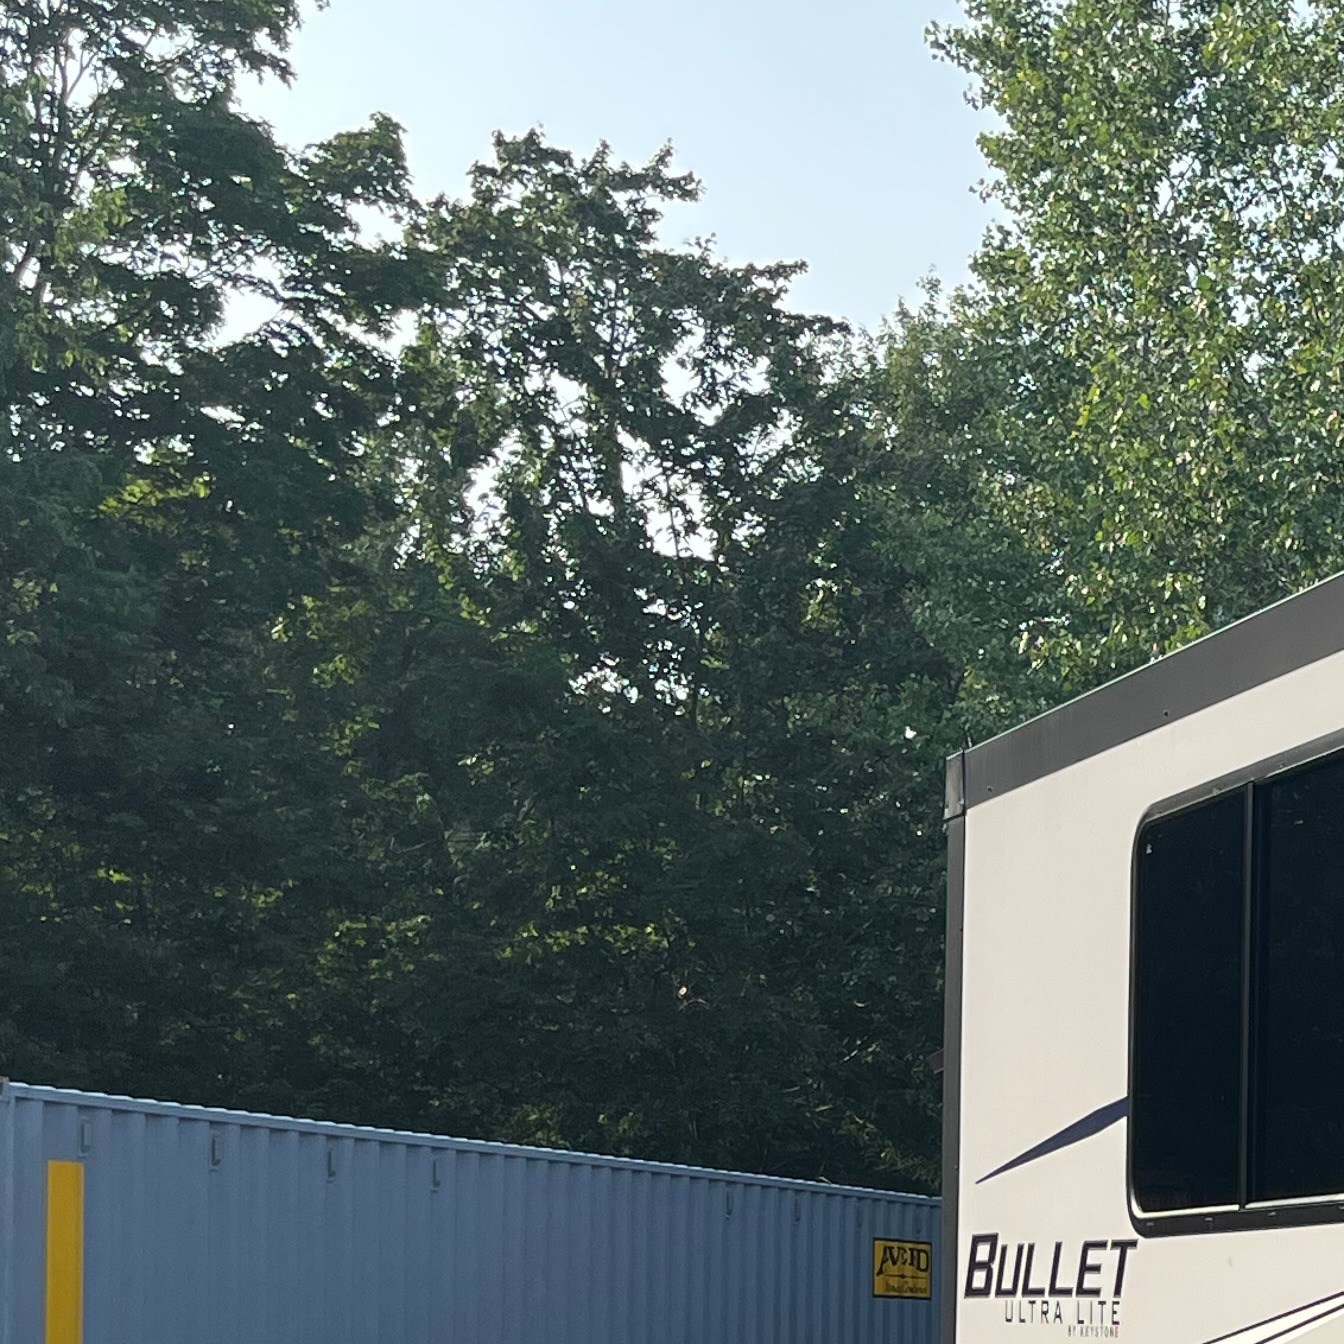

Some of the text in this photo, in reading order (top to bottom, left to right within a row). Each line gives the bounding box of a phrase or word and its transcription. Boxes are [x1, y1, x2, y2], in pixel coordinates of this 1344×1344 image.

[964, 1232, 1139, 1298] BULLET
[1005, 1300, 1120, 1325] ULTRA LITE
[1068, 1325, 1119, 1338] BY KEYSTONE
